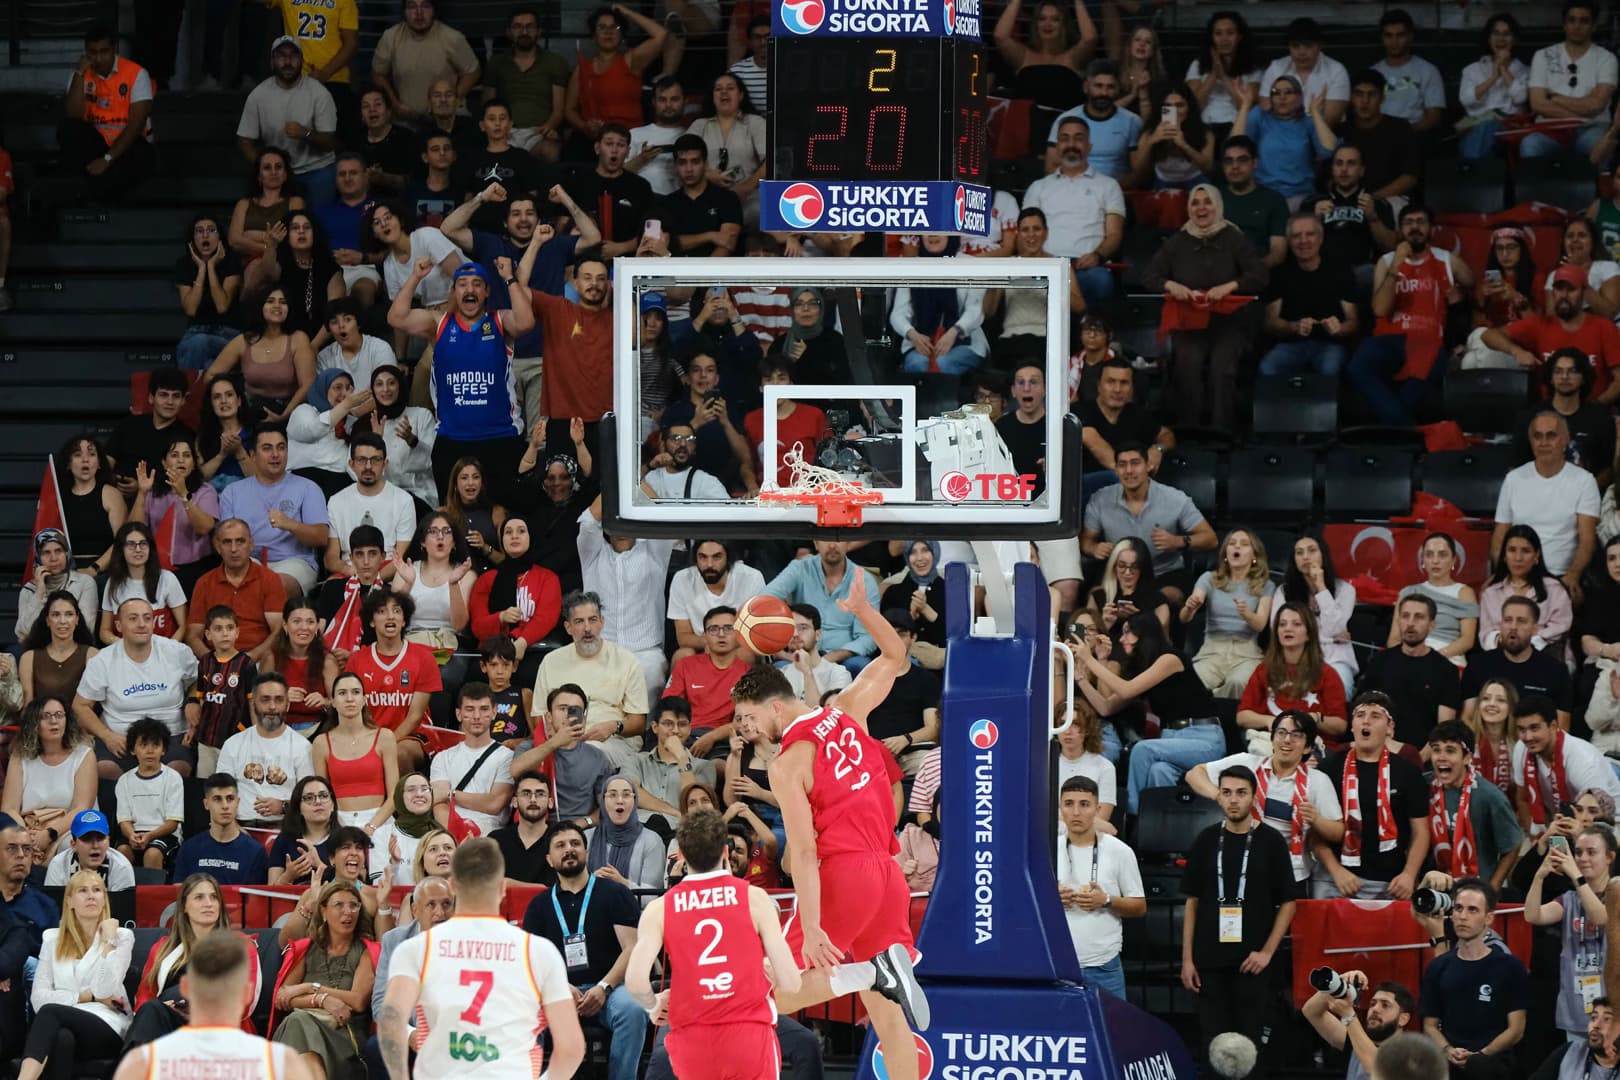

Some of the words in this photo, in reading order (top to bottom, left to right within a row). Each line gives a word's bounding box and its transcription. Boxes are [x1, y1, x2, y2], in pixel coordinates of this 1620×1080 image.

[298, 11, 327, 40] 23
[868, 49, 896, 92] 2
[807, 105, 908, 171] 20
[446, 371, 495, 385] ANADOLU
[453, 383, 488, 395] EFES
[975, 473, 1037, 501] TBF
[123, 683, 157, 697] adidas
[826, 727, 863, 780] 23
[674, 886, 738, 913] HAZER
[694, 918, 728, 966] 2
[459, 969, 494, 1026] 7
